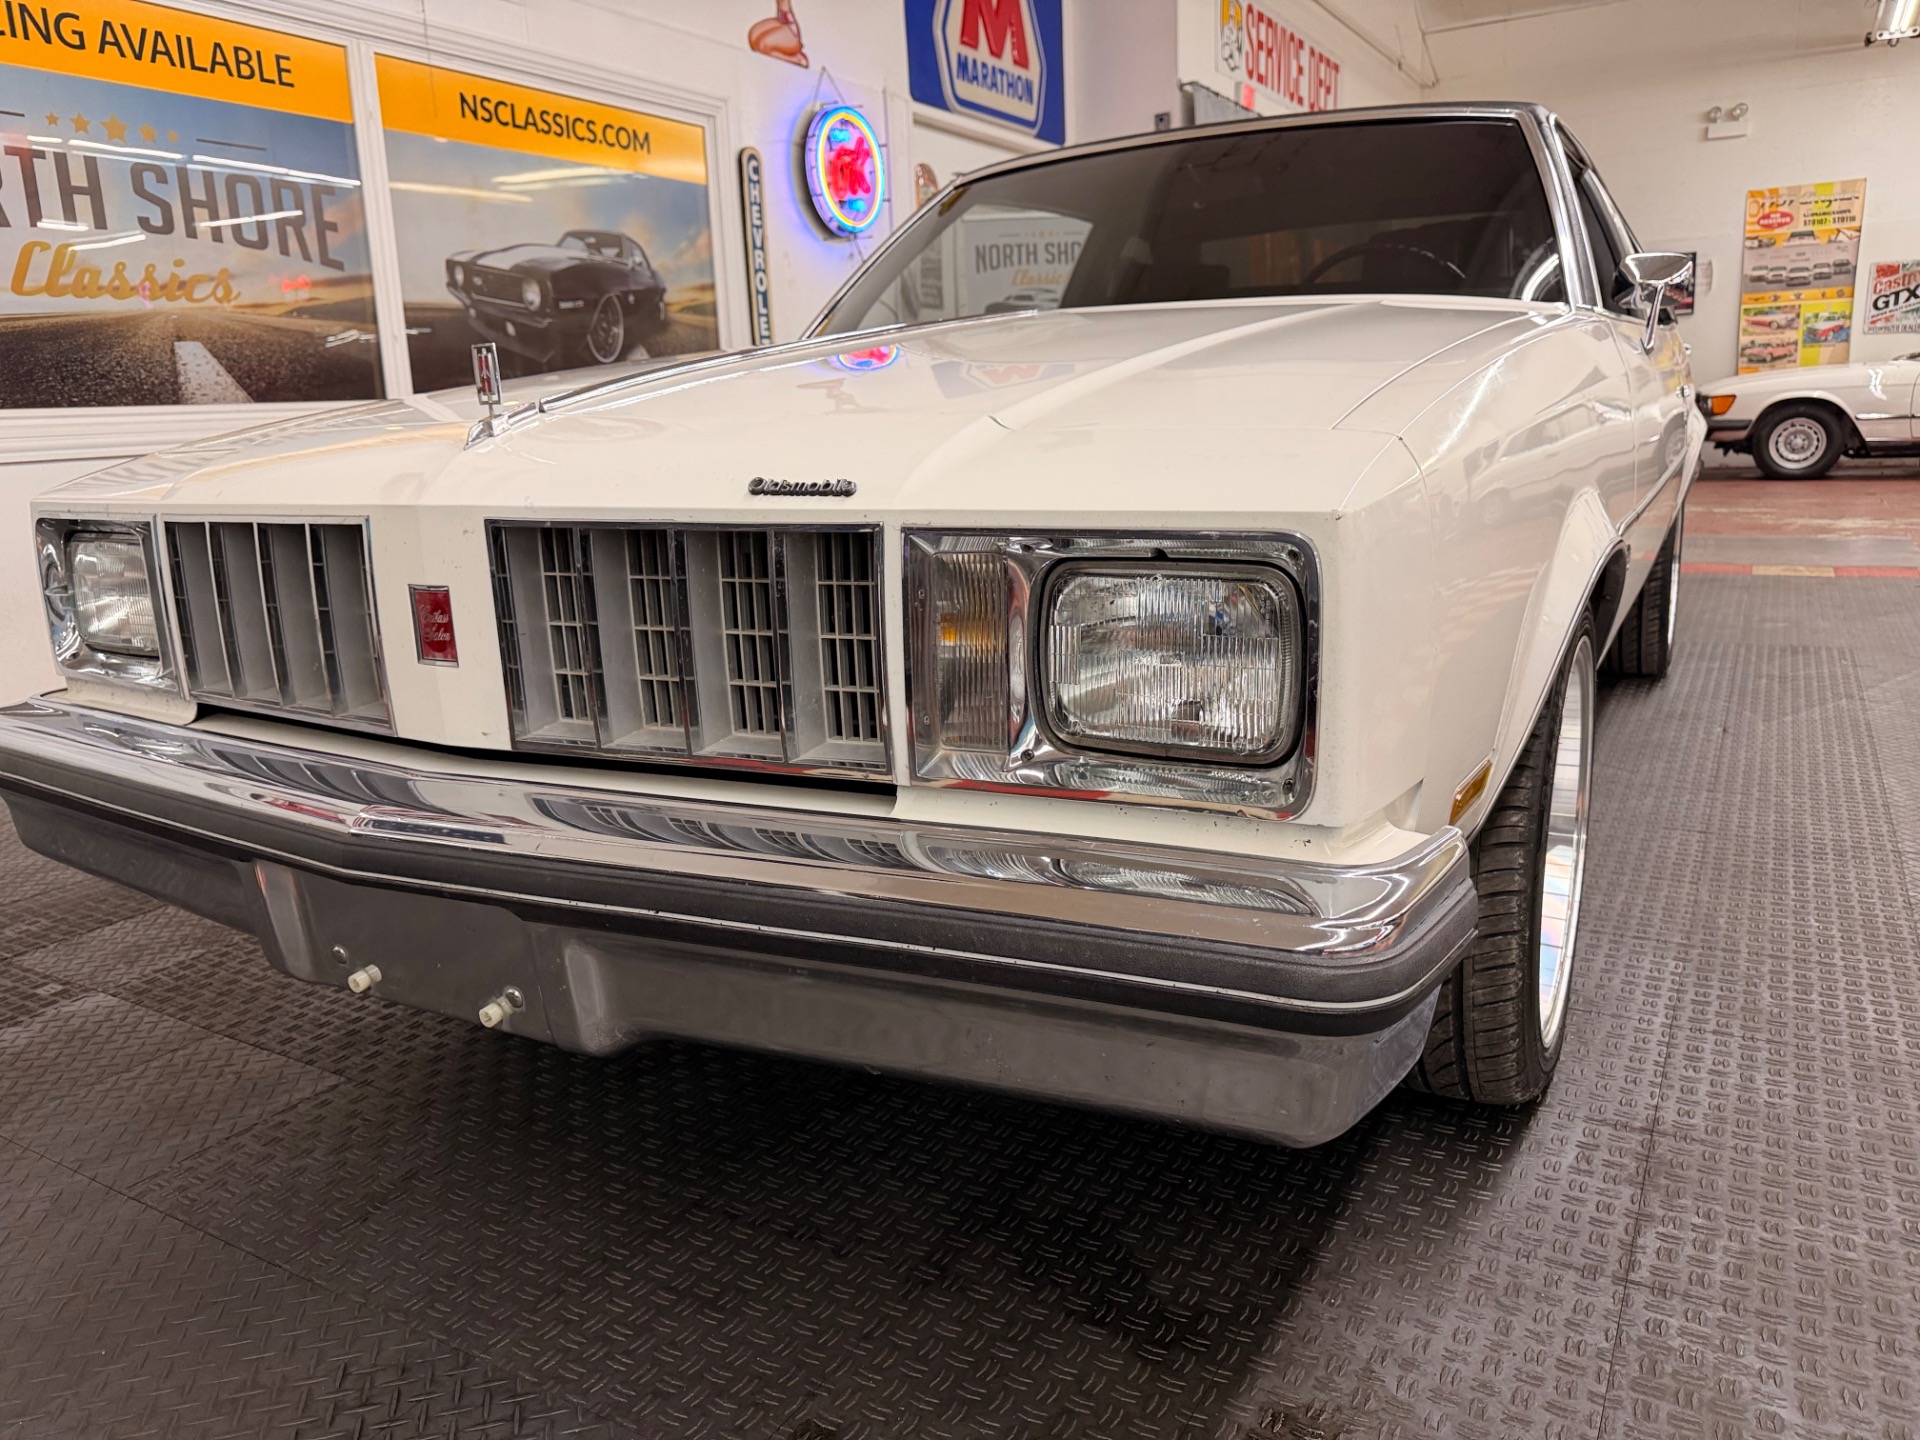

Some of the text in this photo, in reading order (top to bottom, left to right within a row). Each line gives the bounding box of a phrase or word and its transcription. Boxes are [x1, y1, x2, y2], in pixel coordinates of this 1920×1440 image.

[0, 1, 295, 88] ING AVAILABLE
[960, 0, 1030, 70] M
[1245, 3, 1340, 112] SERVICE DEPT
[957, 52, 1034, 106] MARATHON
[459, 91, 652, 155] NSCLASSICS.COM
[829, 136, 872, 200] OK
[0, 144, 345, 272] TH SHORE
[10, 240, 241, 304] Classics
[975, 242, 1038, 275] NORTH
[1872, 283, 1920, 311] GTX
[748, 477, 857, 498] Oldsmobile
[420, 605, 449, 623] Cutlass
[423, 624, 451, 642] Salon
